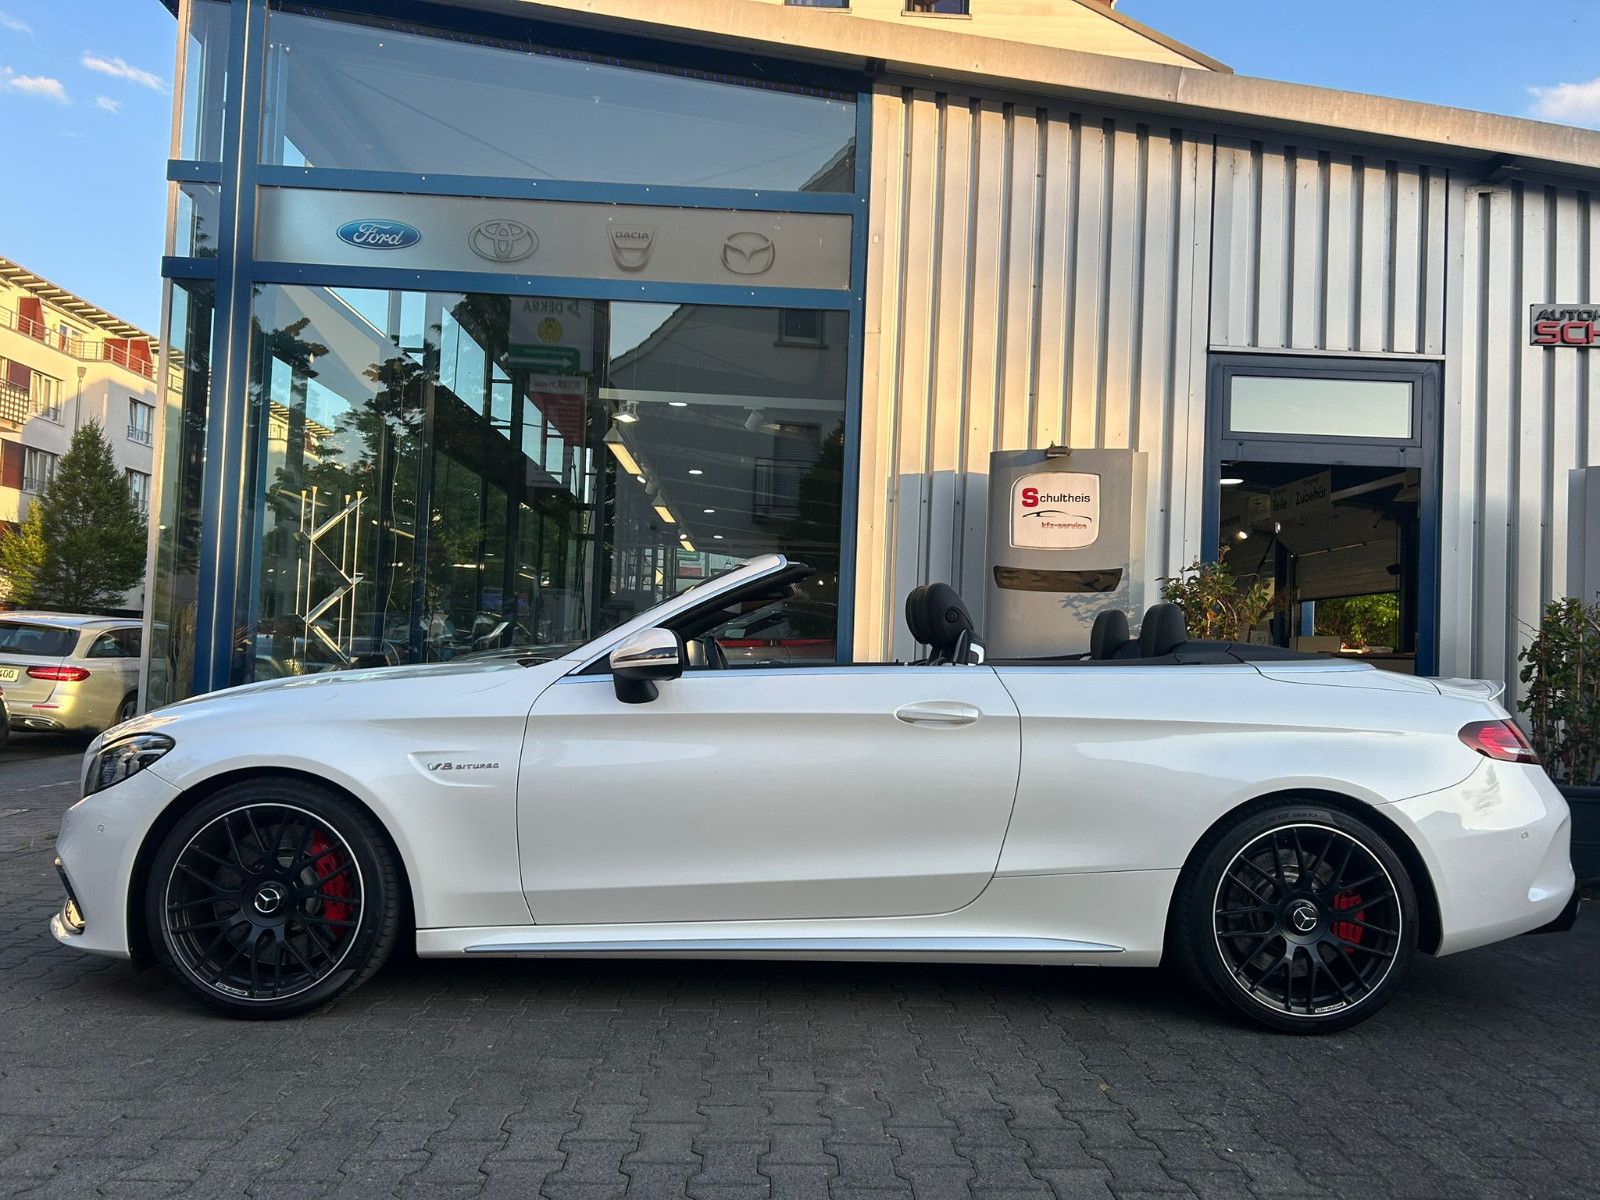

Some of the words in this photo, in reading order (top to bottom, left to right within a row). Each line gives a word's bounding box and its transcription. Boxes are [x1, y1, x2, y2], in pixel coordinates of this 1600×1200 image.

[353, 223, 404, 245] Ford
[615, 231, 649, 239] DACIA
[1022, 488, 1091, 507] Schultheis
[427, 762, 454, 771] V8
[455, 762, 500, 770] BITURBO
